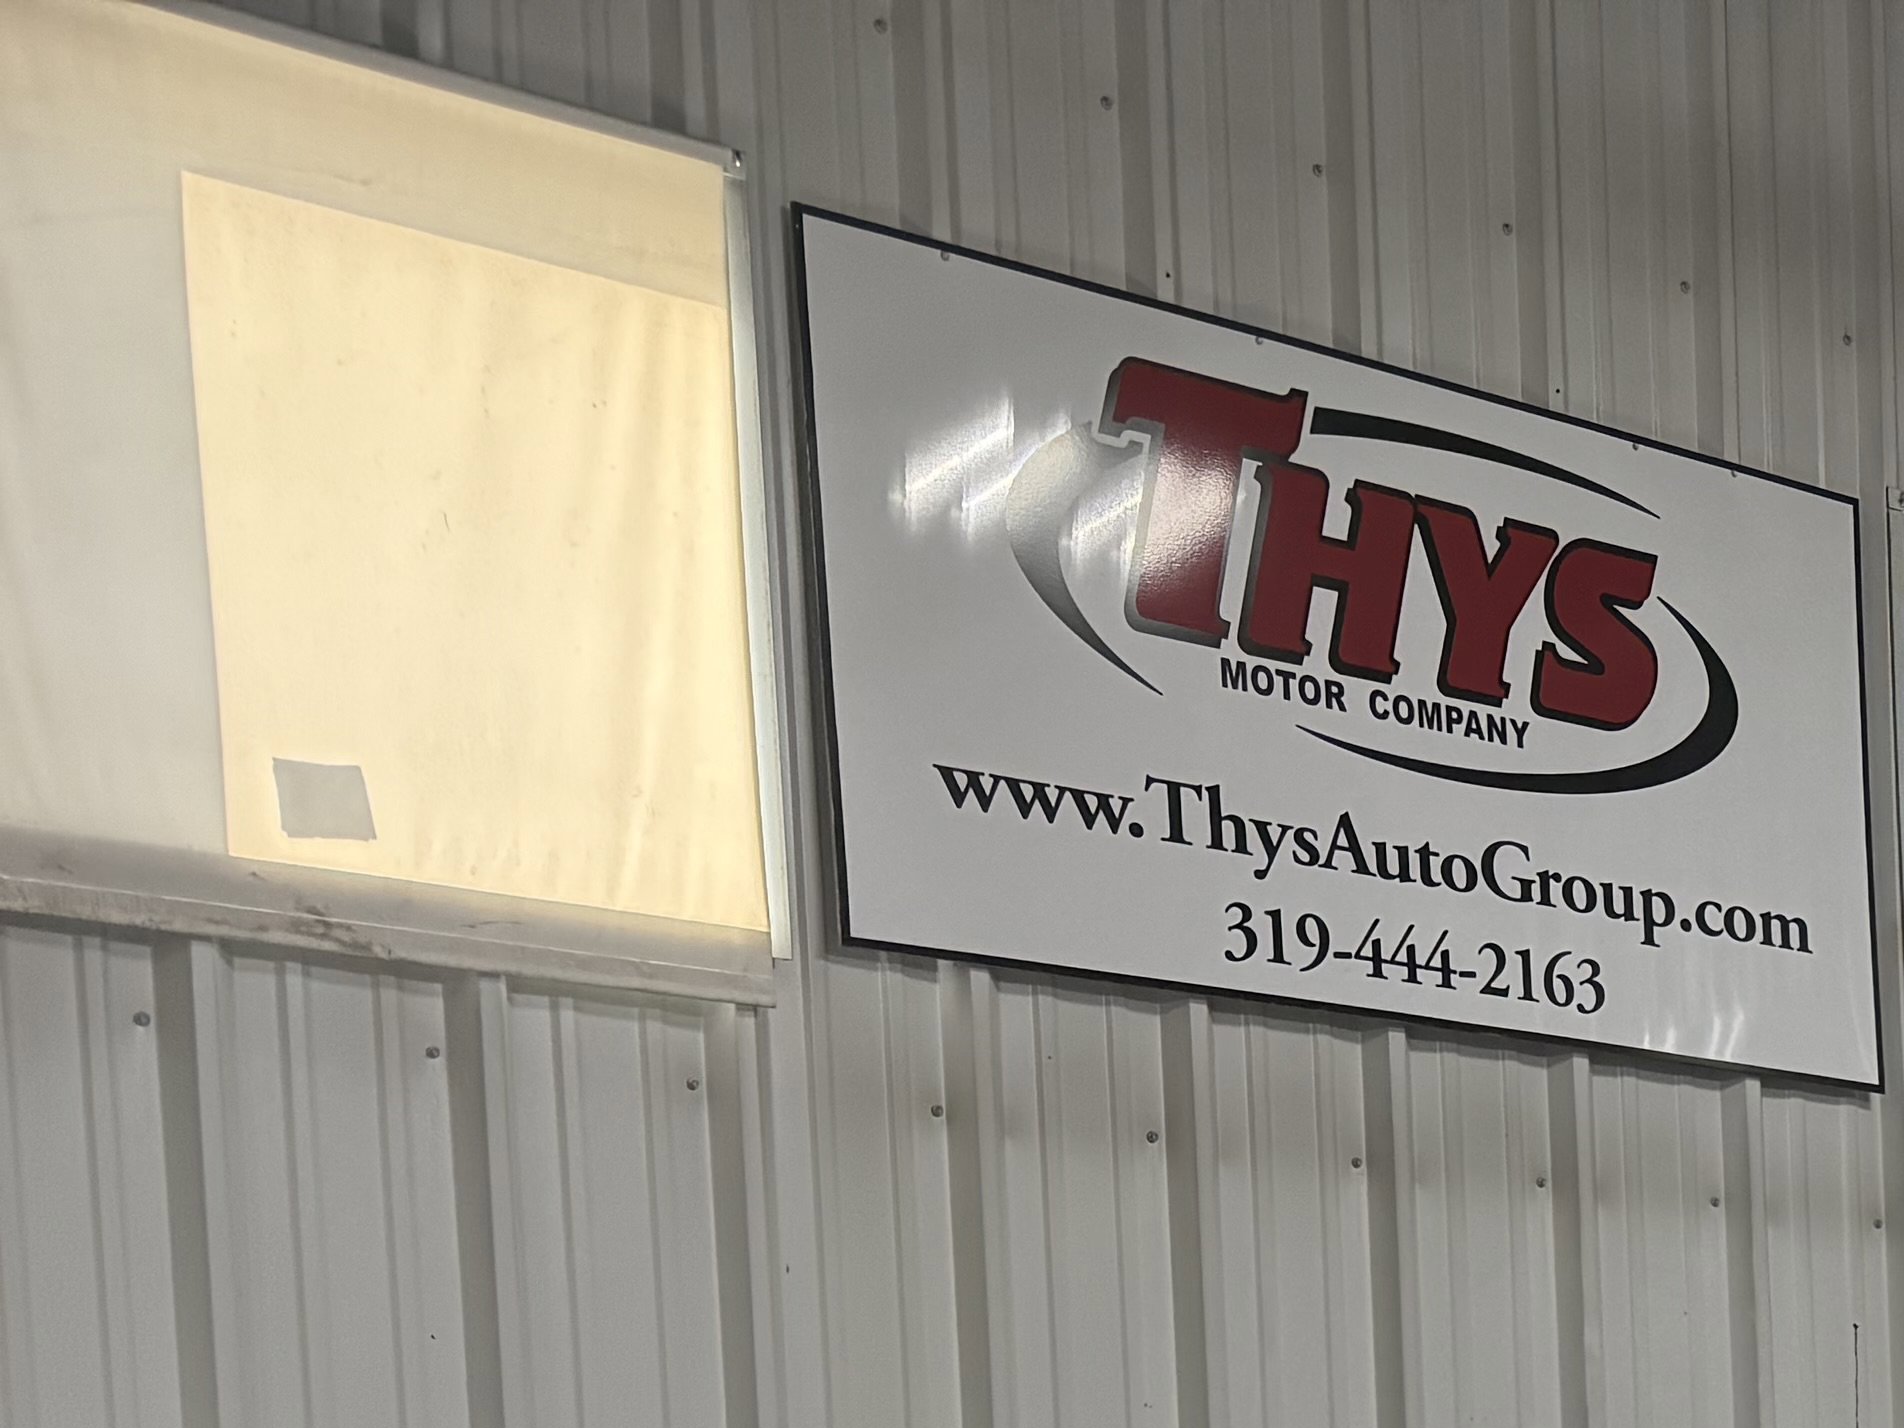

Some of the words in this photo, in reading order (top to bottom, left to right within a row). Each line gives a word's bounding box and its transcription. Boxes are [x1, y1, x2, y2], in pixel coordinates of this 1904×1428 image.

[1099, 356, 1659, 733] THYS
[1220, 656, 1347, 714] MOTOR
[1368, 687, 1532, 750] COMPANY
[933, 760, 1813, 955] www.ThysAutoGroup.com
[1223, 901, 1608, 1015] 319-444-2163
